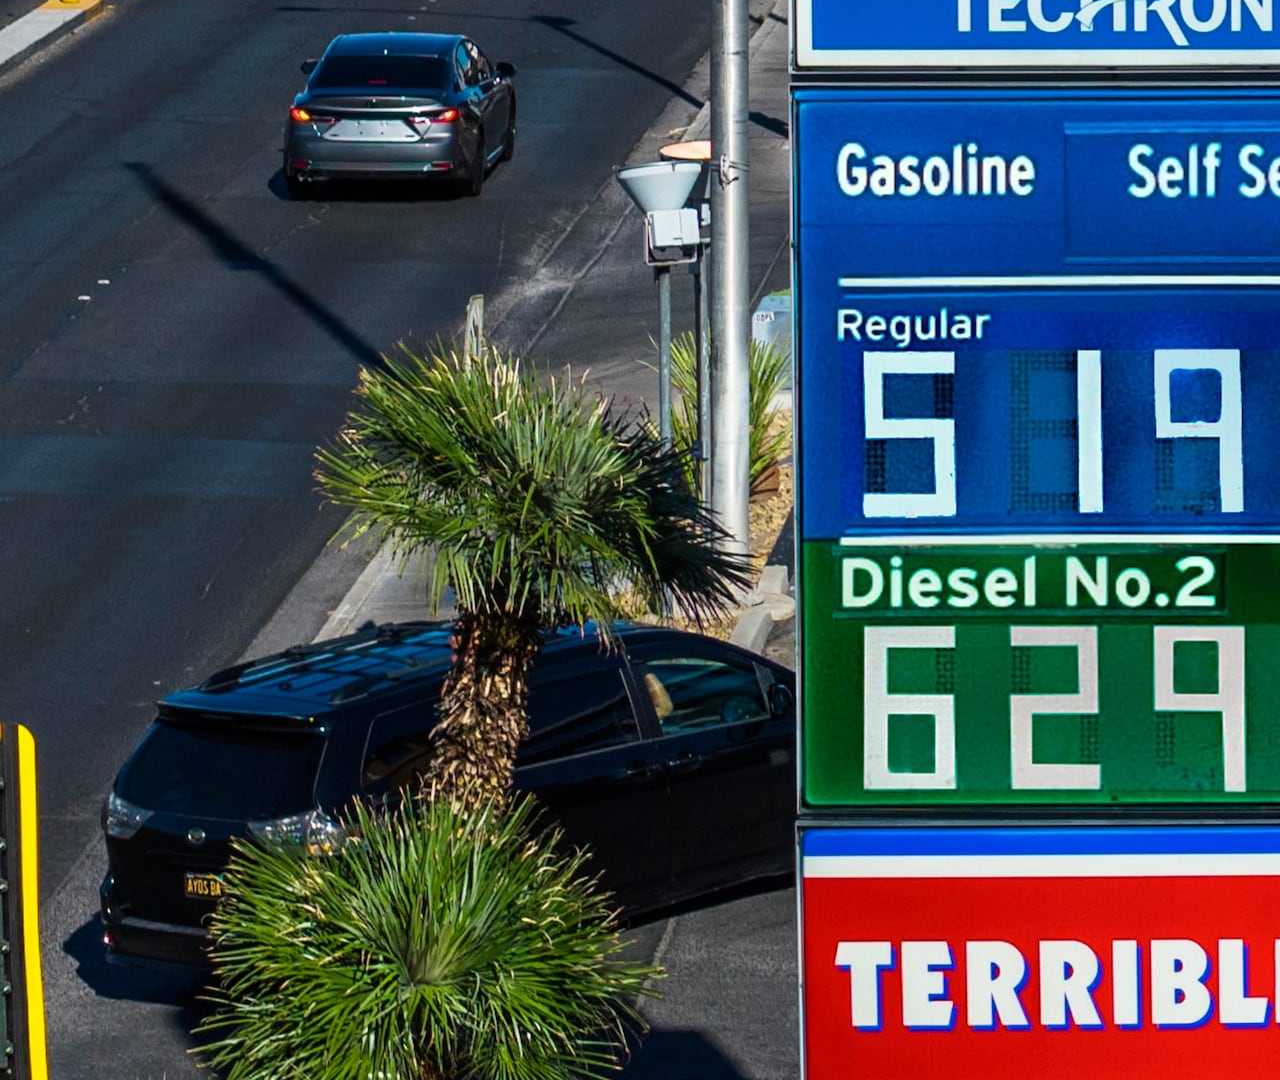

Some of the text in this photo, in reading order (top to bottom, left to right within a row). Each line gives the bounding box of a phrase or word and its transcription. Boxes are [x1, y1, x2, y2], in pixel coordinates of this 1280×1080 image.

[836, 141, 1036, 199] Gasoline
[1127, 141, 1223, 199] Self
[837, 308, 992, 347] Regular
[841, 556, 1218, 609] Diesel No.2
